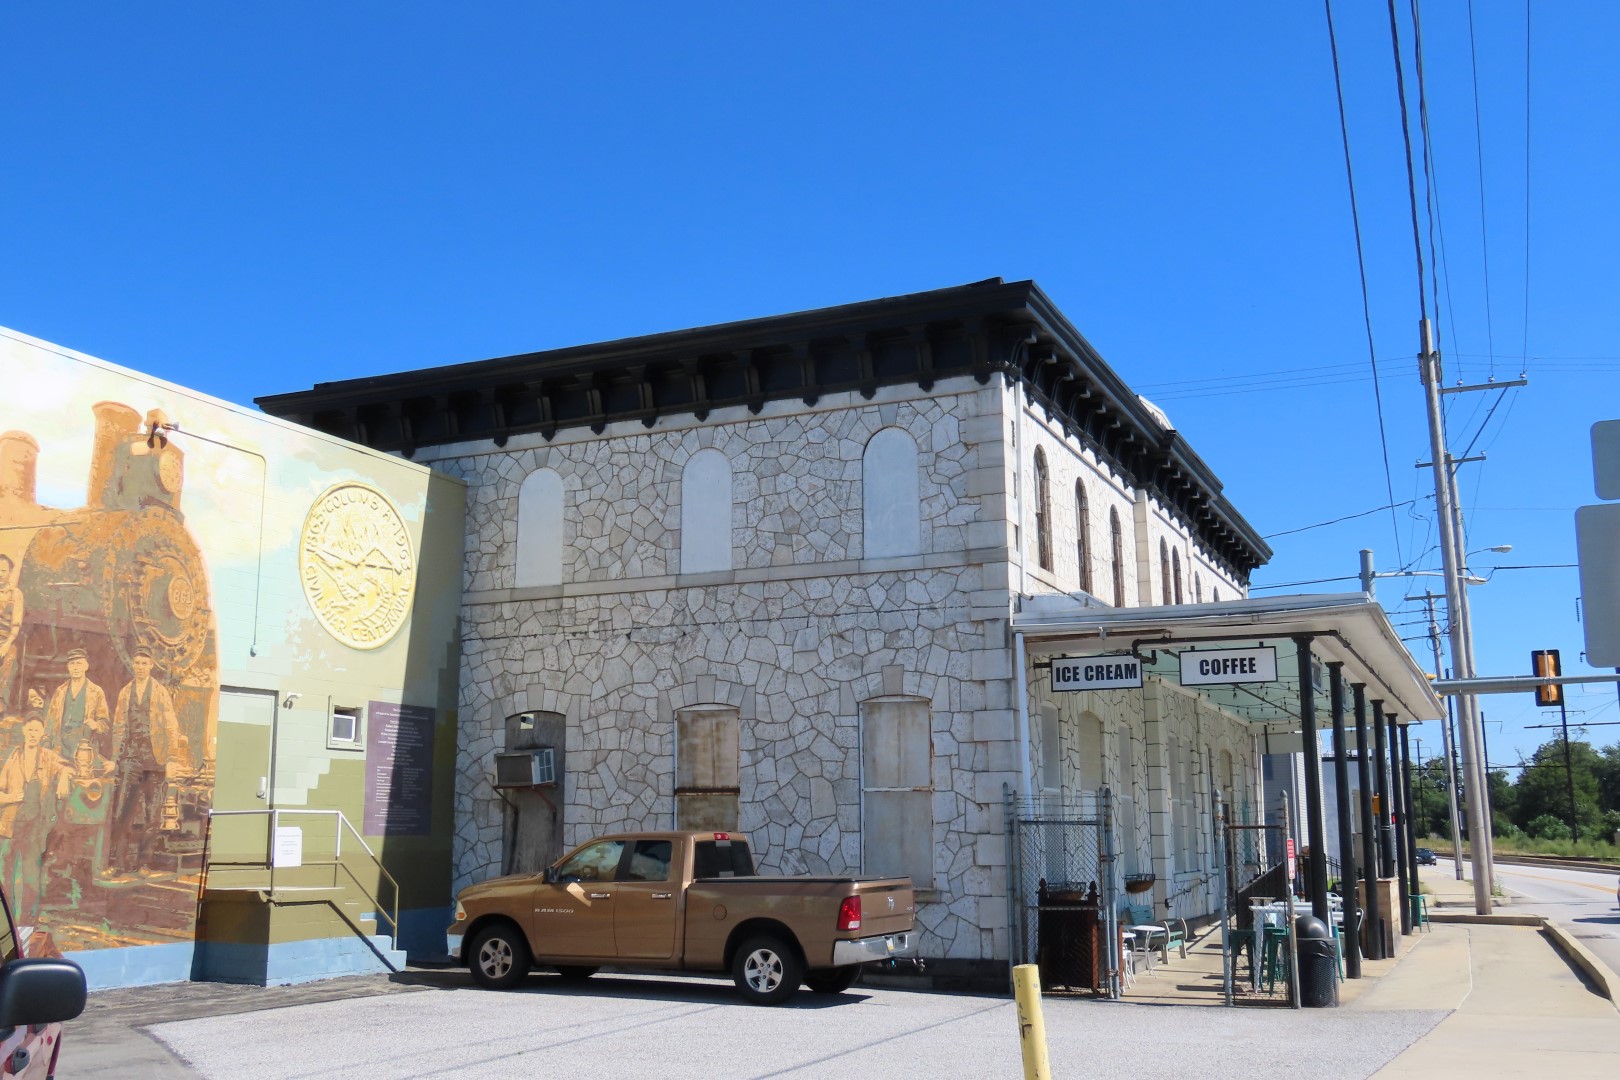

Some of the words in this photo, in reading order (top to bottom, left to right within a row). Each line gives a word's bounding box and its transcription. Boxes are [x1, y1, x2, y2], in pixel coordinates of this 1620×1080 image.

[1055, 666, 1080, 683] ICE
[1084, 663, 1138, 682] CREAM
[1199, 656, 1257, 676] COFFEE
